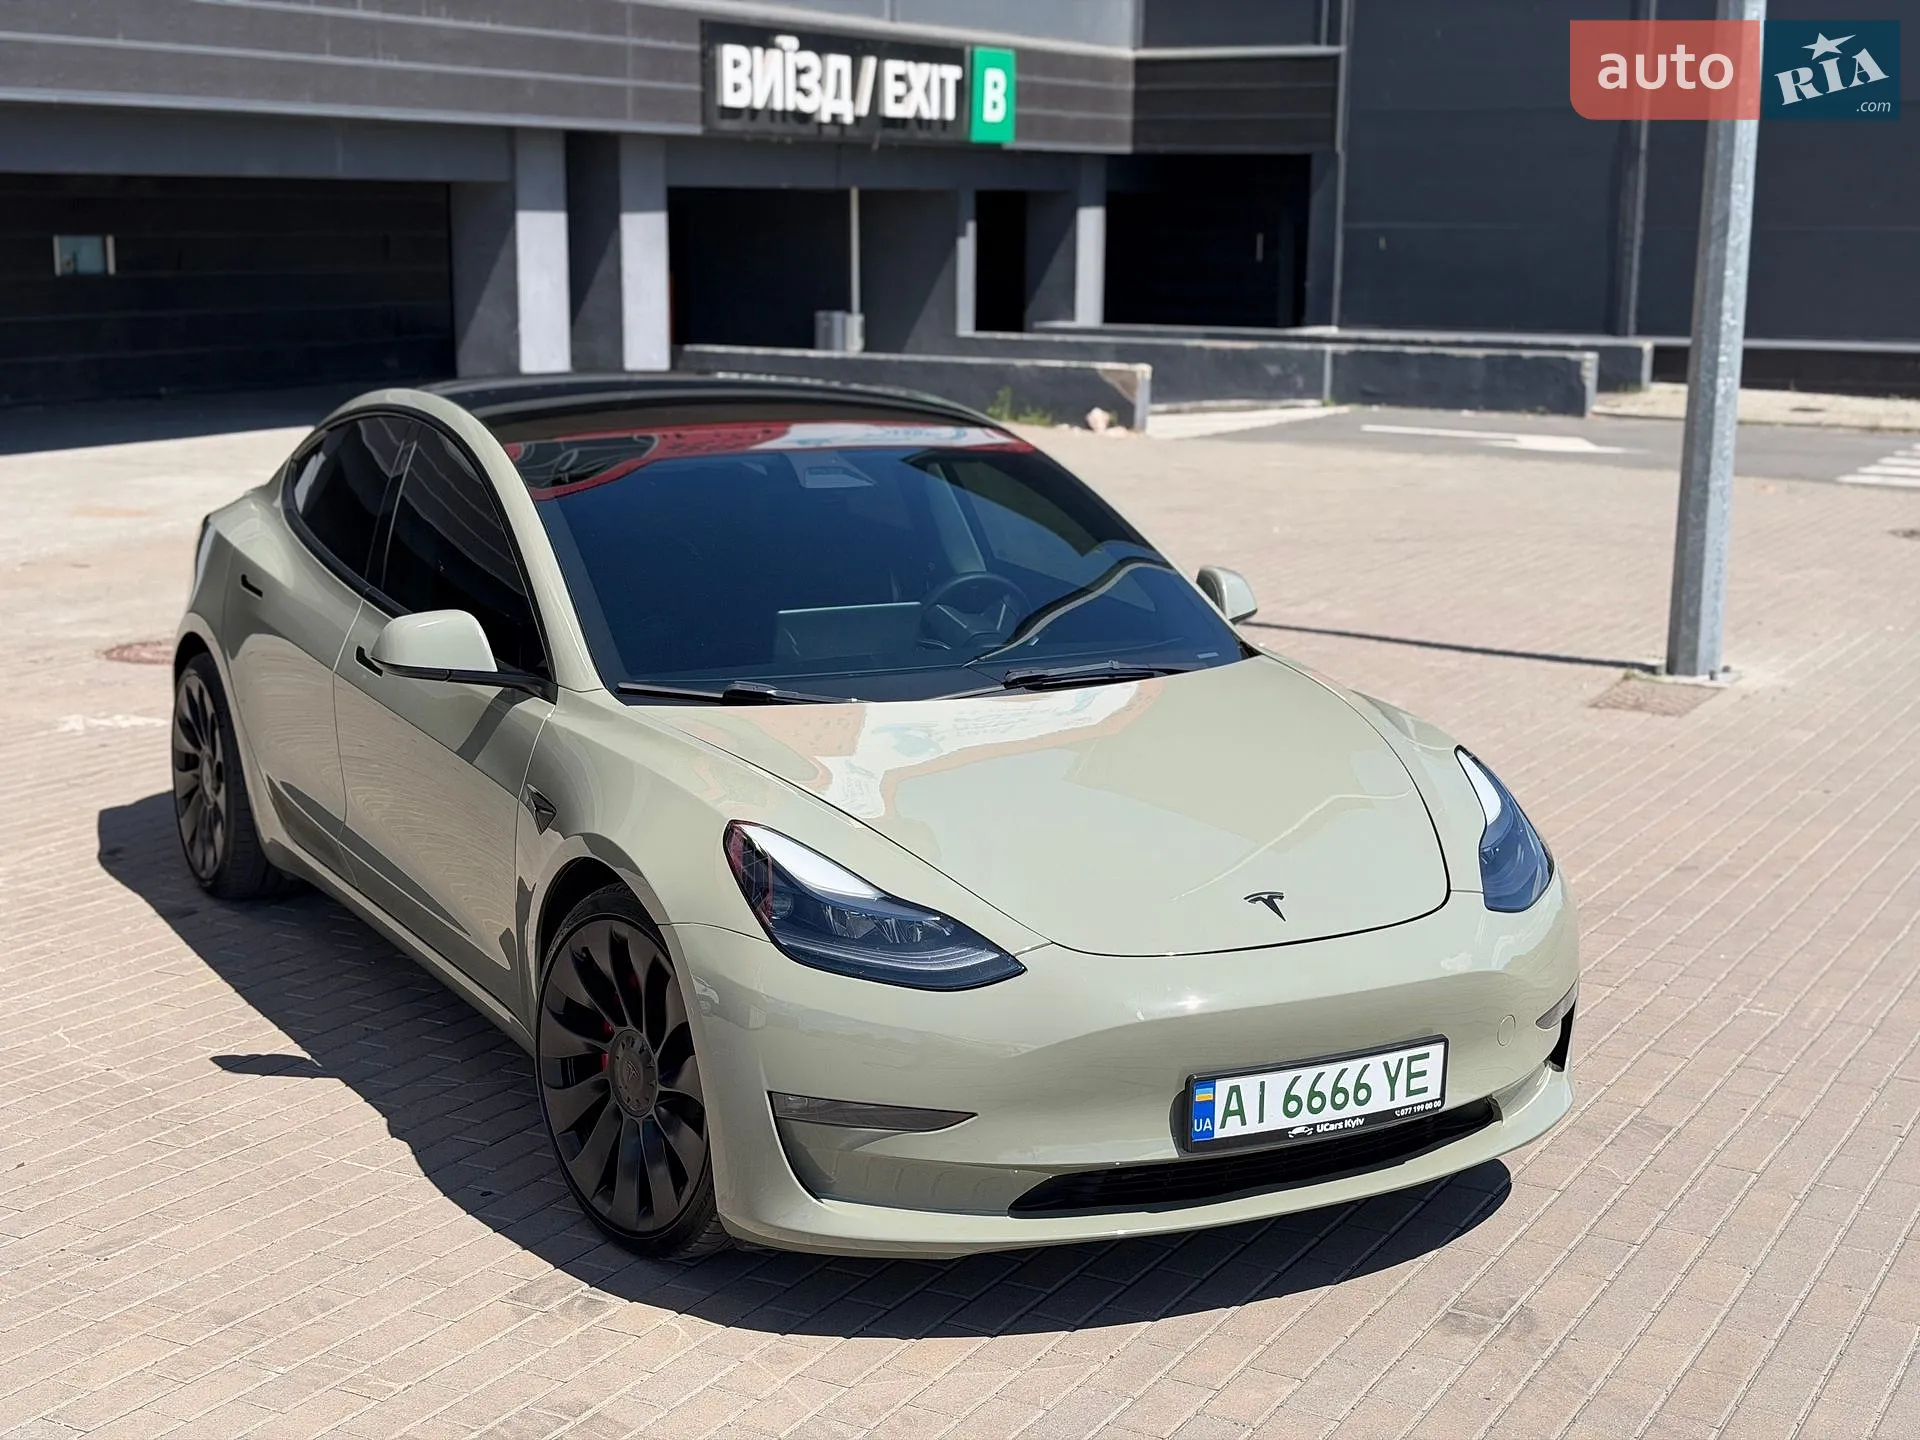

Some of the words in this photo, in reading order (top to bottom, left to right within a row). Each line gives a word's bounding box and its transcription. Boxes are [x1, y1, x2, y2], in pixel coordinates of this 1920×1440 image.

[718, 35, 855, 124] ВИЇЗД
[884, 59, 963, 121] EXIT
[1219, 1081, 1266, 1130] AI
[1282, 1063, 1372, 1119] 6666
[1383, 1052, 1430, 1102] YE
[1400, 1107, 1413, 1116] 077
[1413, 1103, 1425, 1113] 199
[1194, 1118, 1213, 1132] UA
[1316, 1121, 1344, 1133] UCars
[1344, 1117, 1365, 1129] Kyiv
